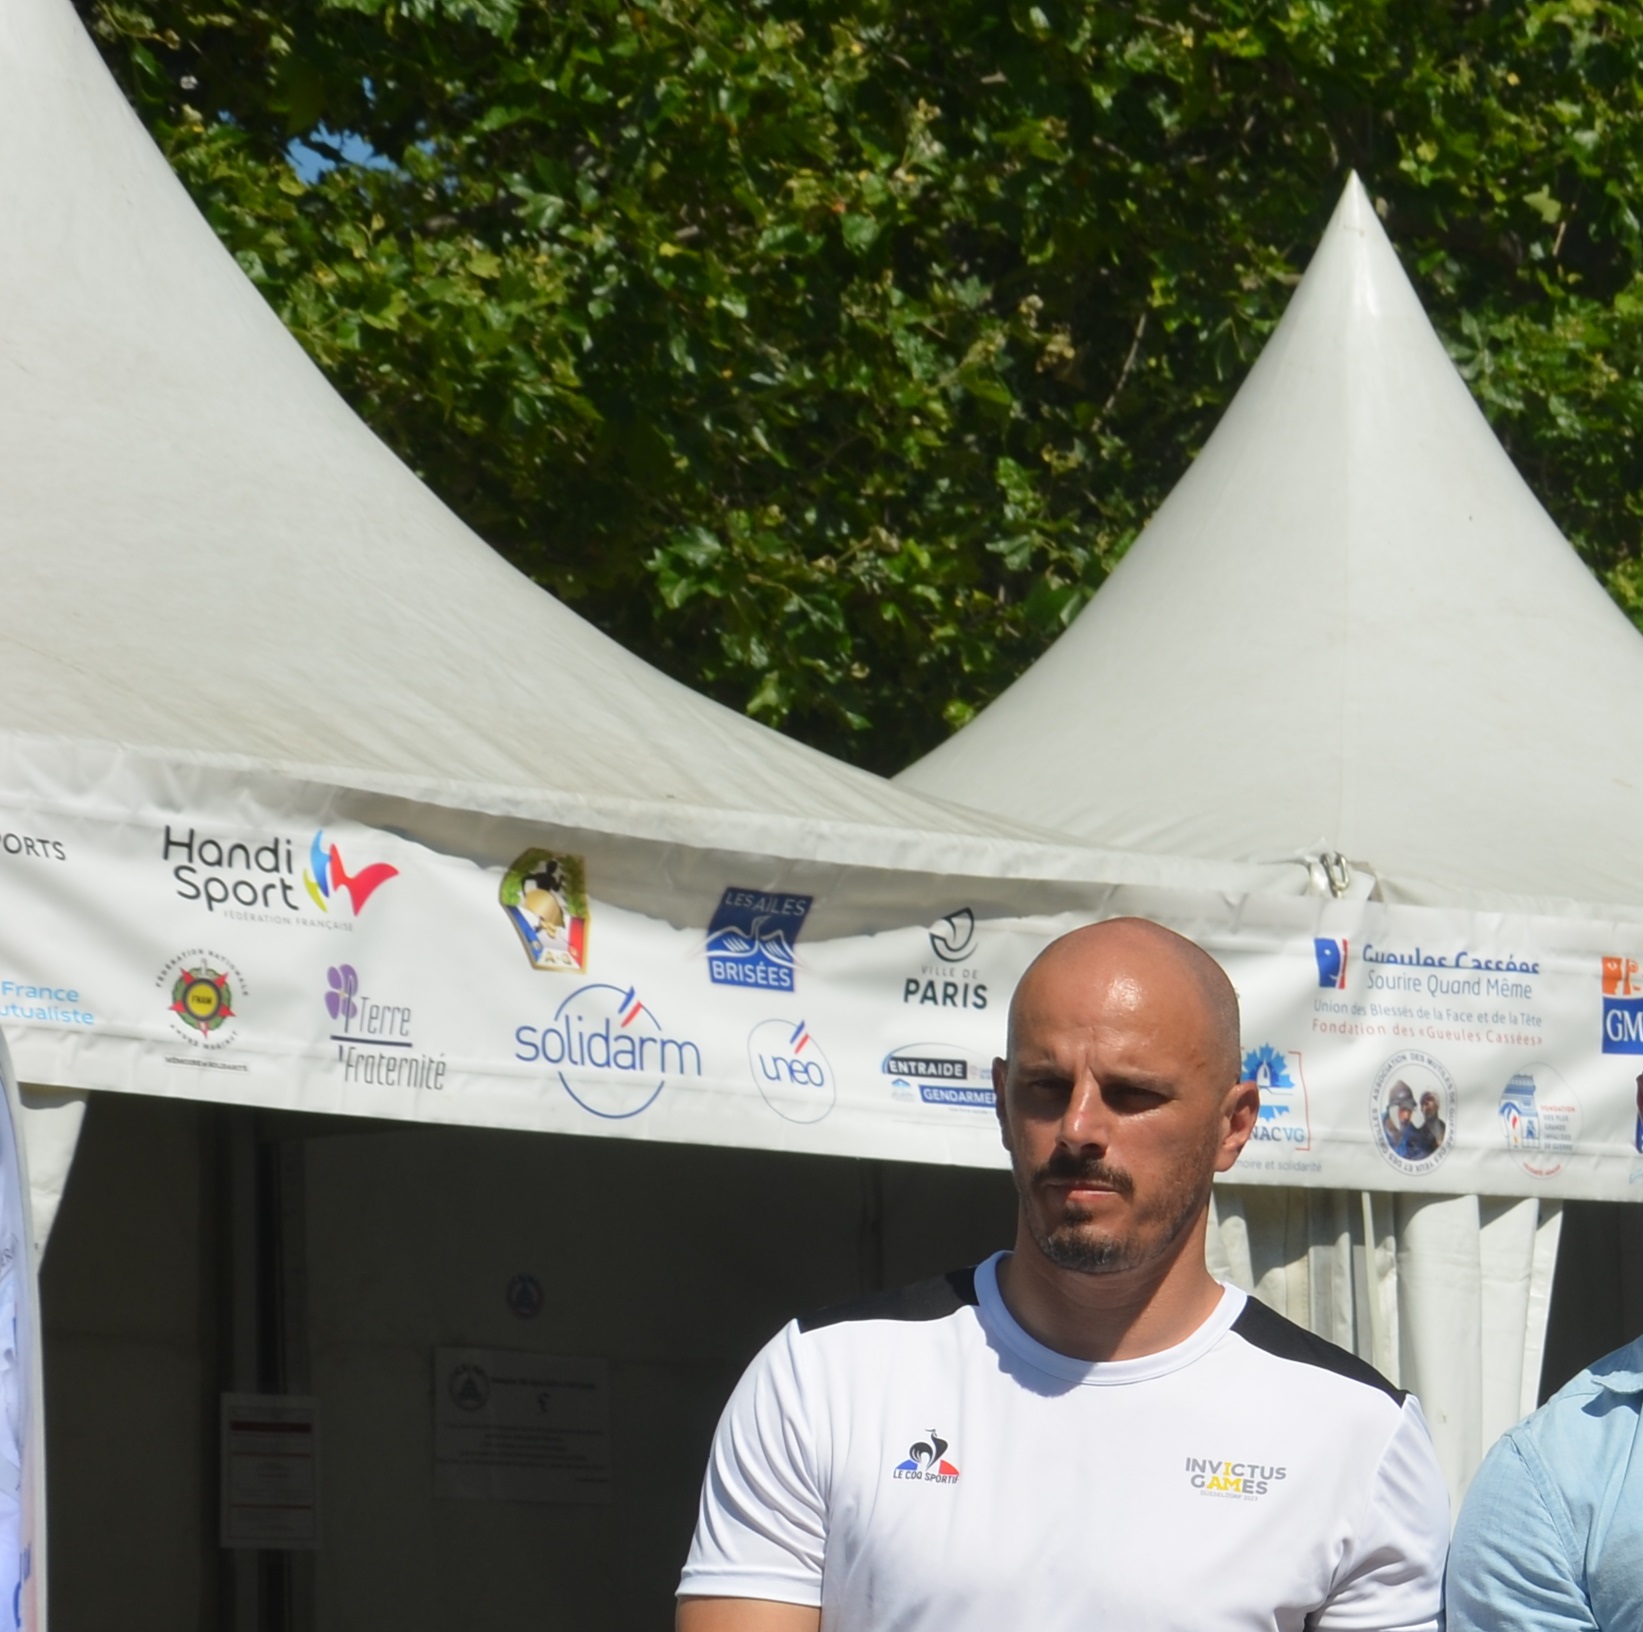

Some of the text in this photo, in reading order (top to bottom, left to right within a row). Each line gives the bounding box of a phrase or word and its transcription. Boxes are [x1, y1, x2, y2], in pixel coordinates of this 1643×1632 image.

[0, 831, 67, 861] ORTS
[163, 825, 293, 874] Handi
[173, 864, 299, 912] Sport
[713, 960, 792, 988] BRISÉES
[922, 965, 979, 979] VILLE DE
[1367, 969, 1532, 999] Sourire Quand Même
[1, 980, 79, 1003] France
[903, 978, 988, 1010] PARIS
[0, 1003, 95, 1025] utualiste
[358, 997, 412, 1038] Terre
[1314, 999, 1348, 1014] Union
[1351, 1002, 1367, 1016] des
[1417, 1006, 1430, 1020] de
[1433, 1007, 1443, 1020] la
[1447, 1008, 1473, 1022] Face
[1477, 1012, 1489, 1023] et
[1492, 1011, 1506, 1024] de
[1509, 1013, 1518, 1025] la
[1312, 1018, 1385, 1035] Fondation
[1393, 1022, 1415, 1037] des
[516, 1014, 701, 1076] solidarm
[344, 1046, 447, 1091] Fraternité
[888, 1060, 965, 1078] ENTRAIDE
[892, 1470, 904, 1480] LE
[1185, 1456, 1287, 1480] INVICTUS
[1190, 1474, 1268, 1496] GAMES
